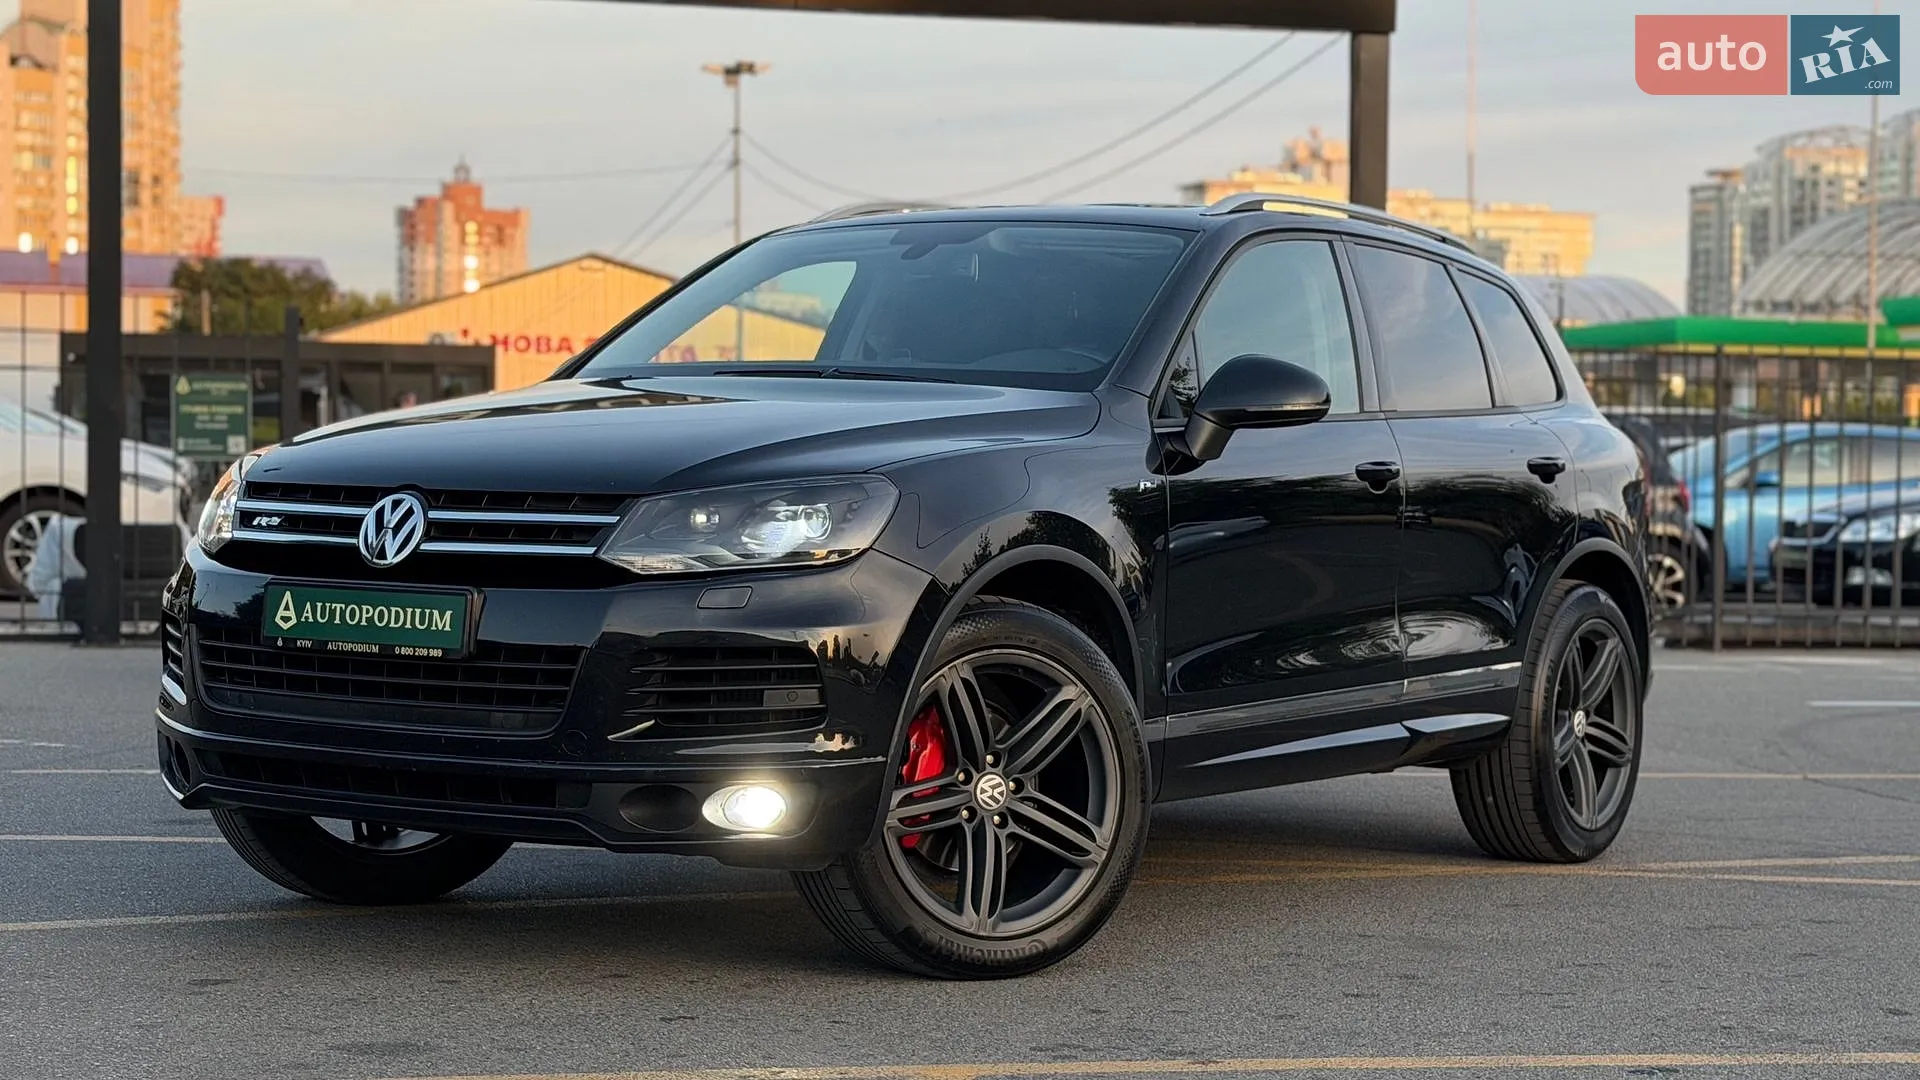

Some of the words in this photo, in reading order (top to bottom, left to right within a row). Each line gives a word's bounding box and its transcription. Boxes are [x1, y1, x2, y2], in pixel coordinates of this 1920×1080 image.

[360, 494, 424, 564] VW
[300, 601, 453, 631] AUTOPODIUM
[297, 639, 312, 648] KYIV
[327, 641, 379, 653] AUTOPODIUM
[415, 648, 428, 656] 209
